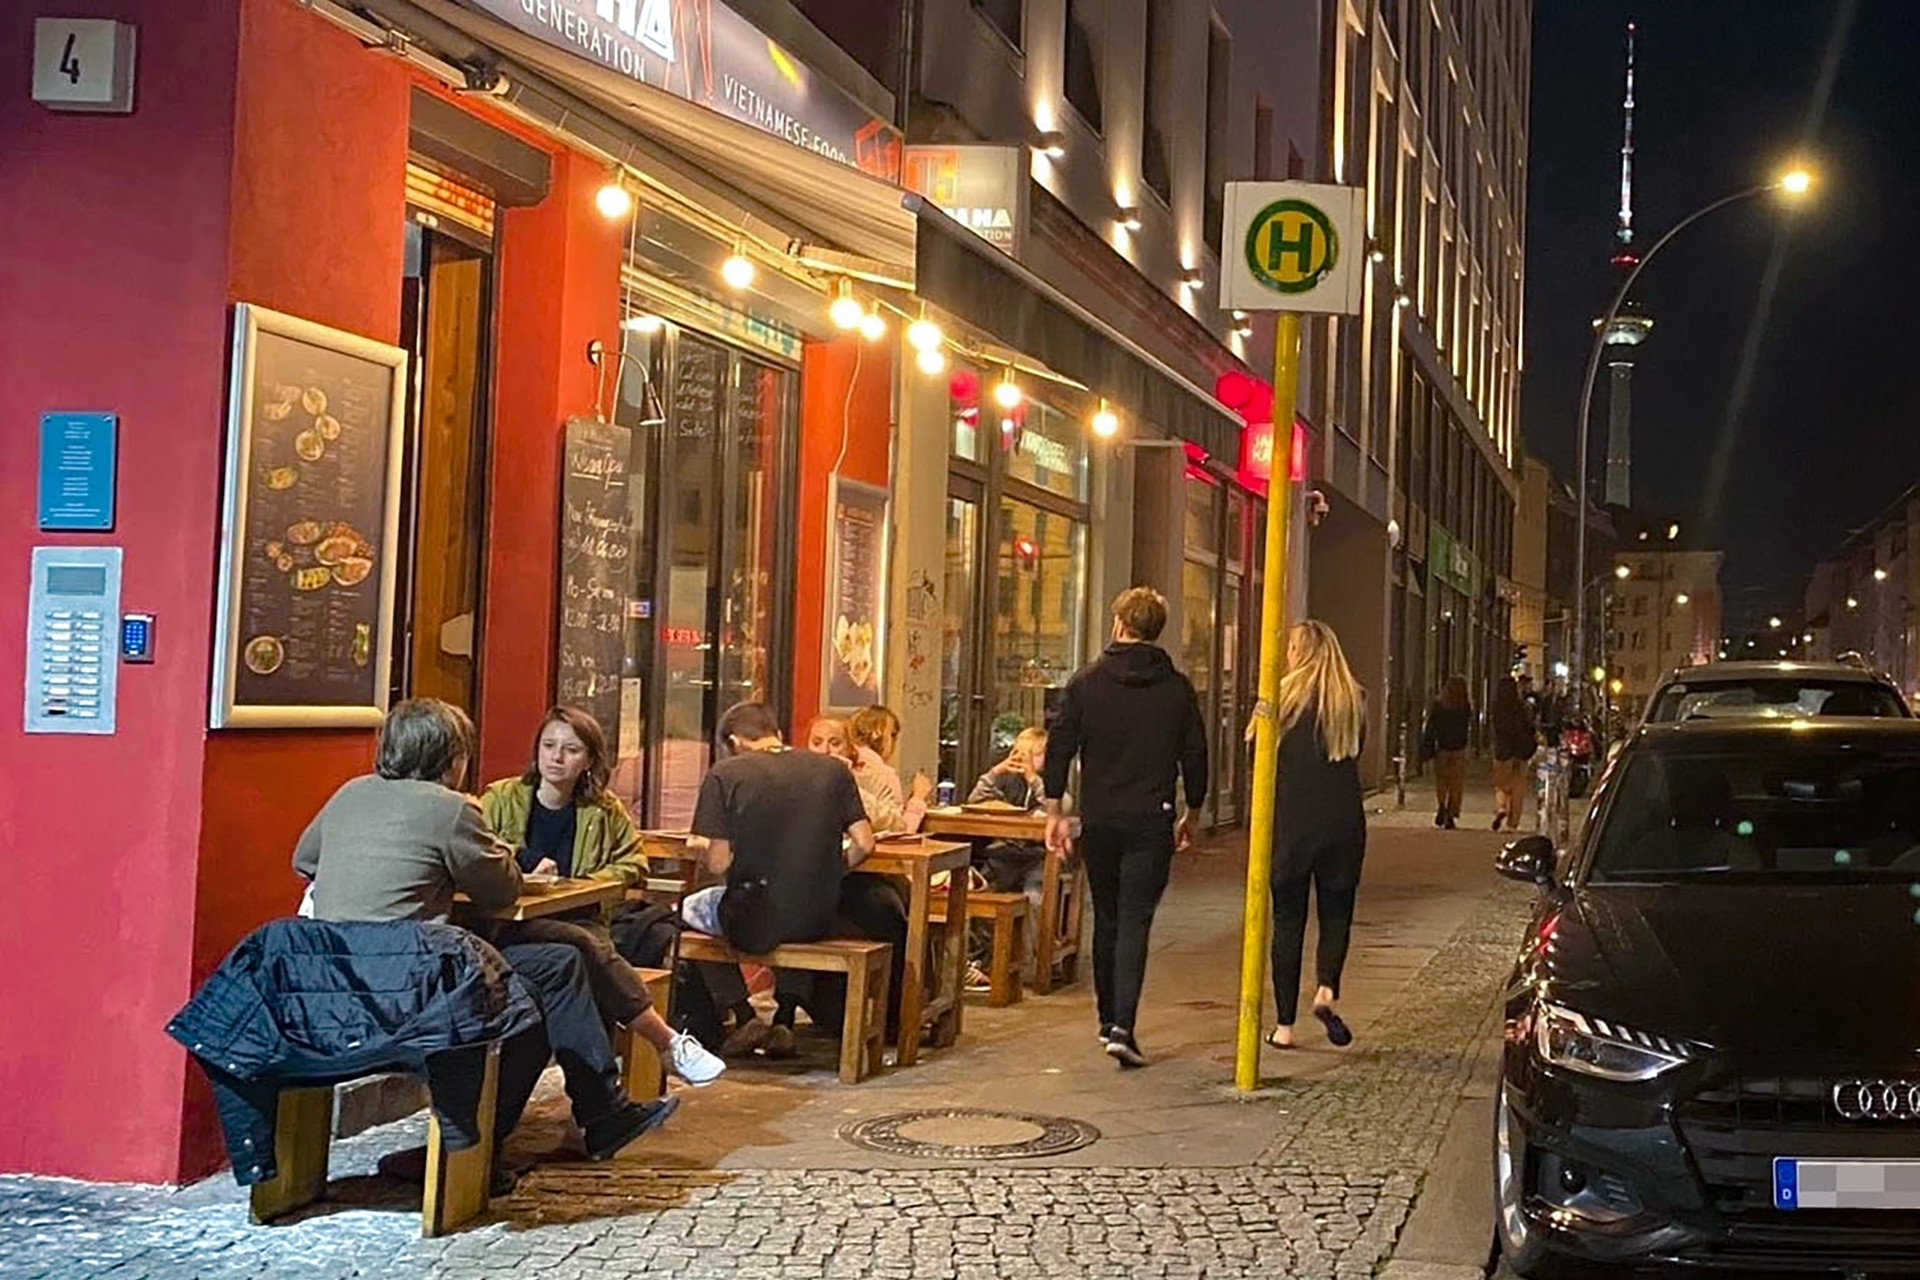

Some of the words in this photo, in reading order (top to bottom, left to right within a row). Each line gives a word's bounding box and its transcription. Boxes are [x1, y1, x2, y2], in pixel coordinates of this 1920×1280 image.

[60, 33, 80, 84] 4
[724, 73, 809, 147] VIETNAMESE
[1268, 220, 1314, 273] H
[1782, 1188, 1792, 1200] D
